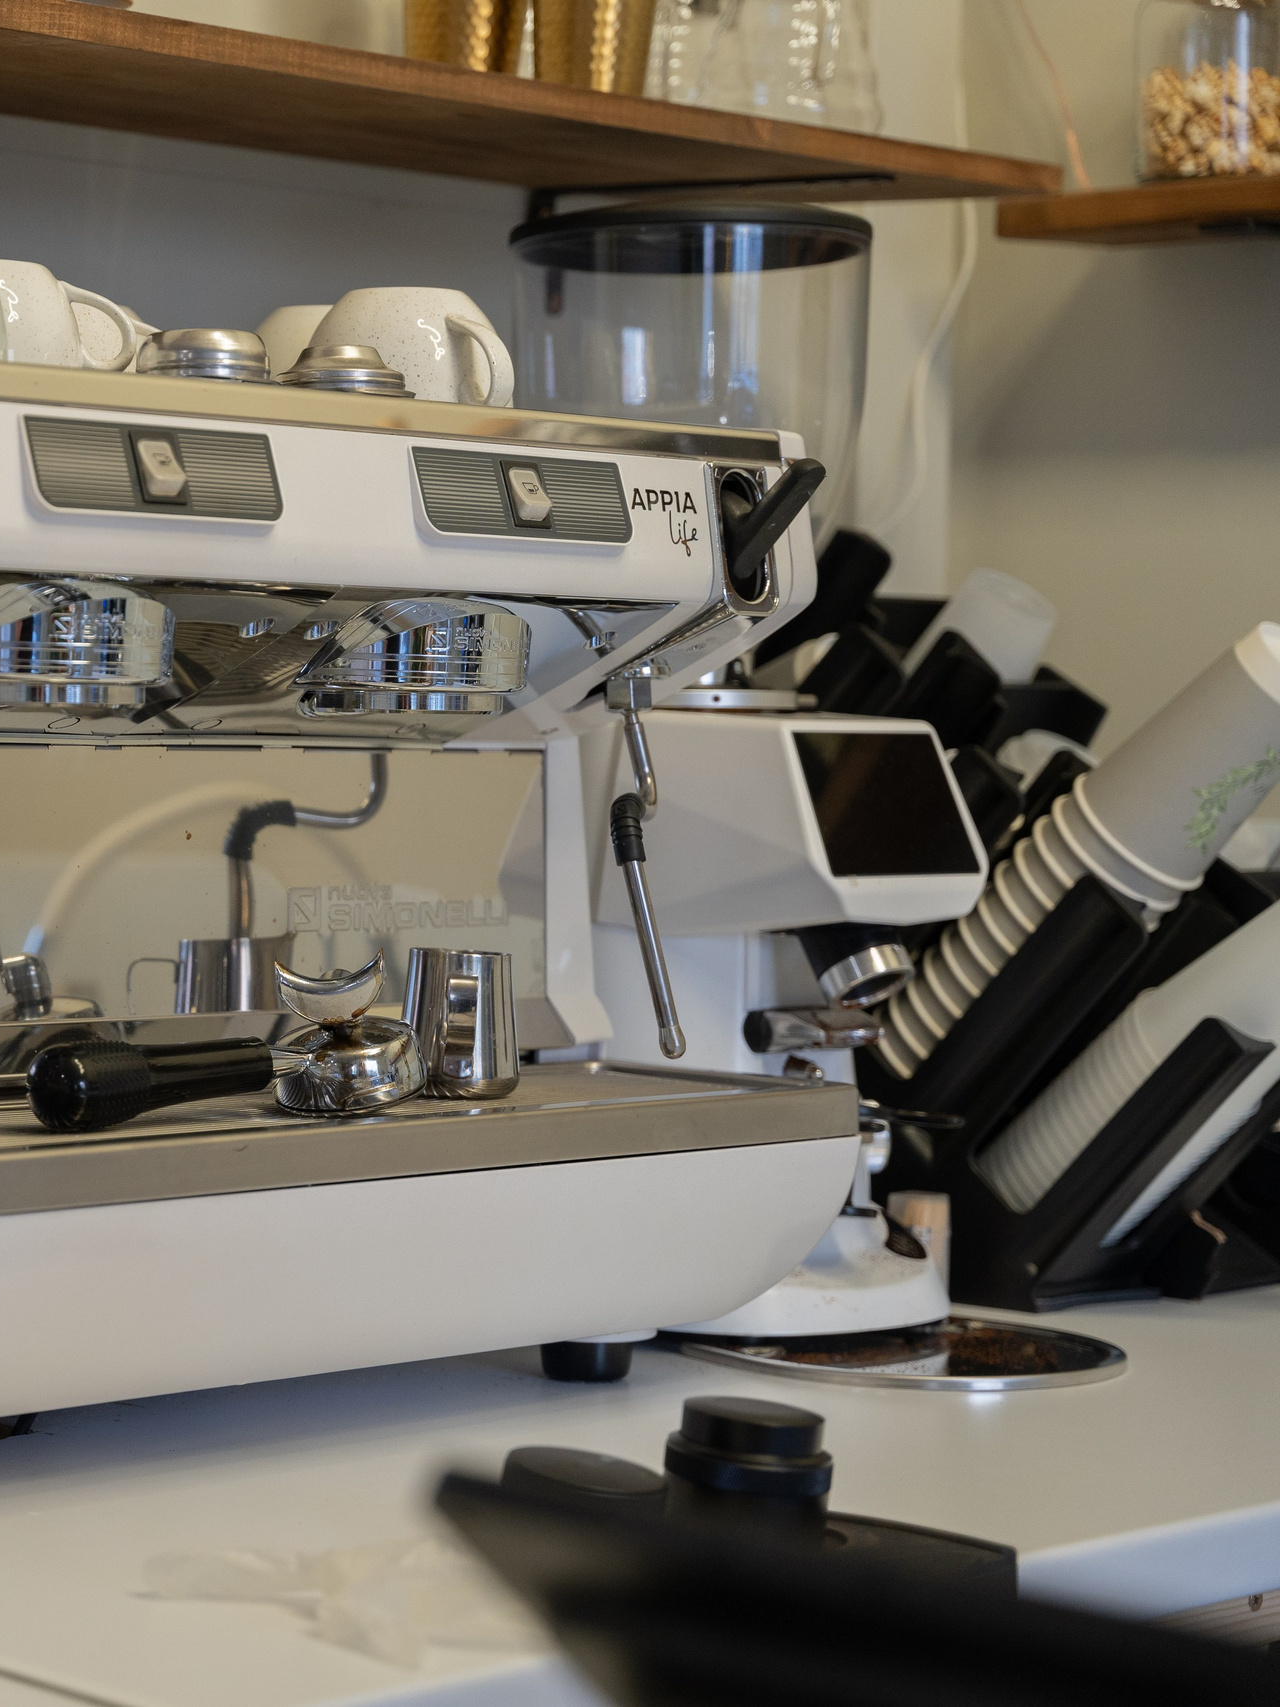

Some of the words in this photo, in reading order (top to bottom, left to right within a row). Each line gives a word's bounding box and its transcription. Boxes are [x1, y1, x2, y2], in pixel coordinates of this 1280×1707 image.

[631, 488, 698, 514] APPIA
[668, 510, 699, 557] life
[328, 885, 393, 901] nuova
[328, 900, 509, 933] SIMONELLI
